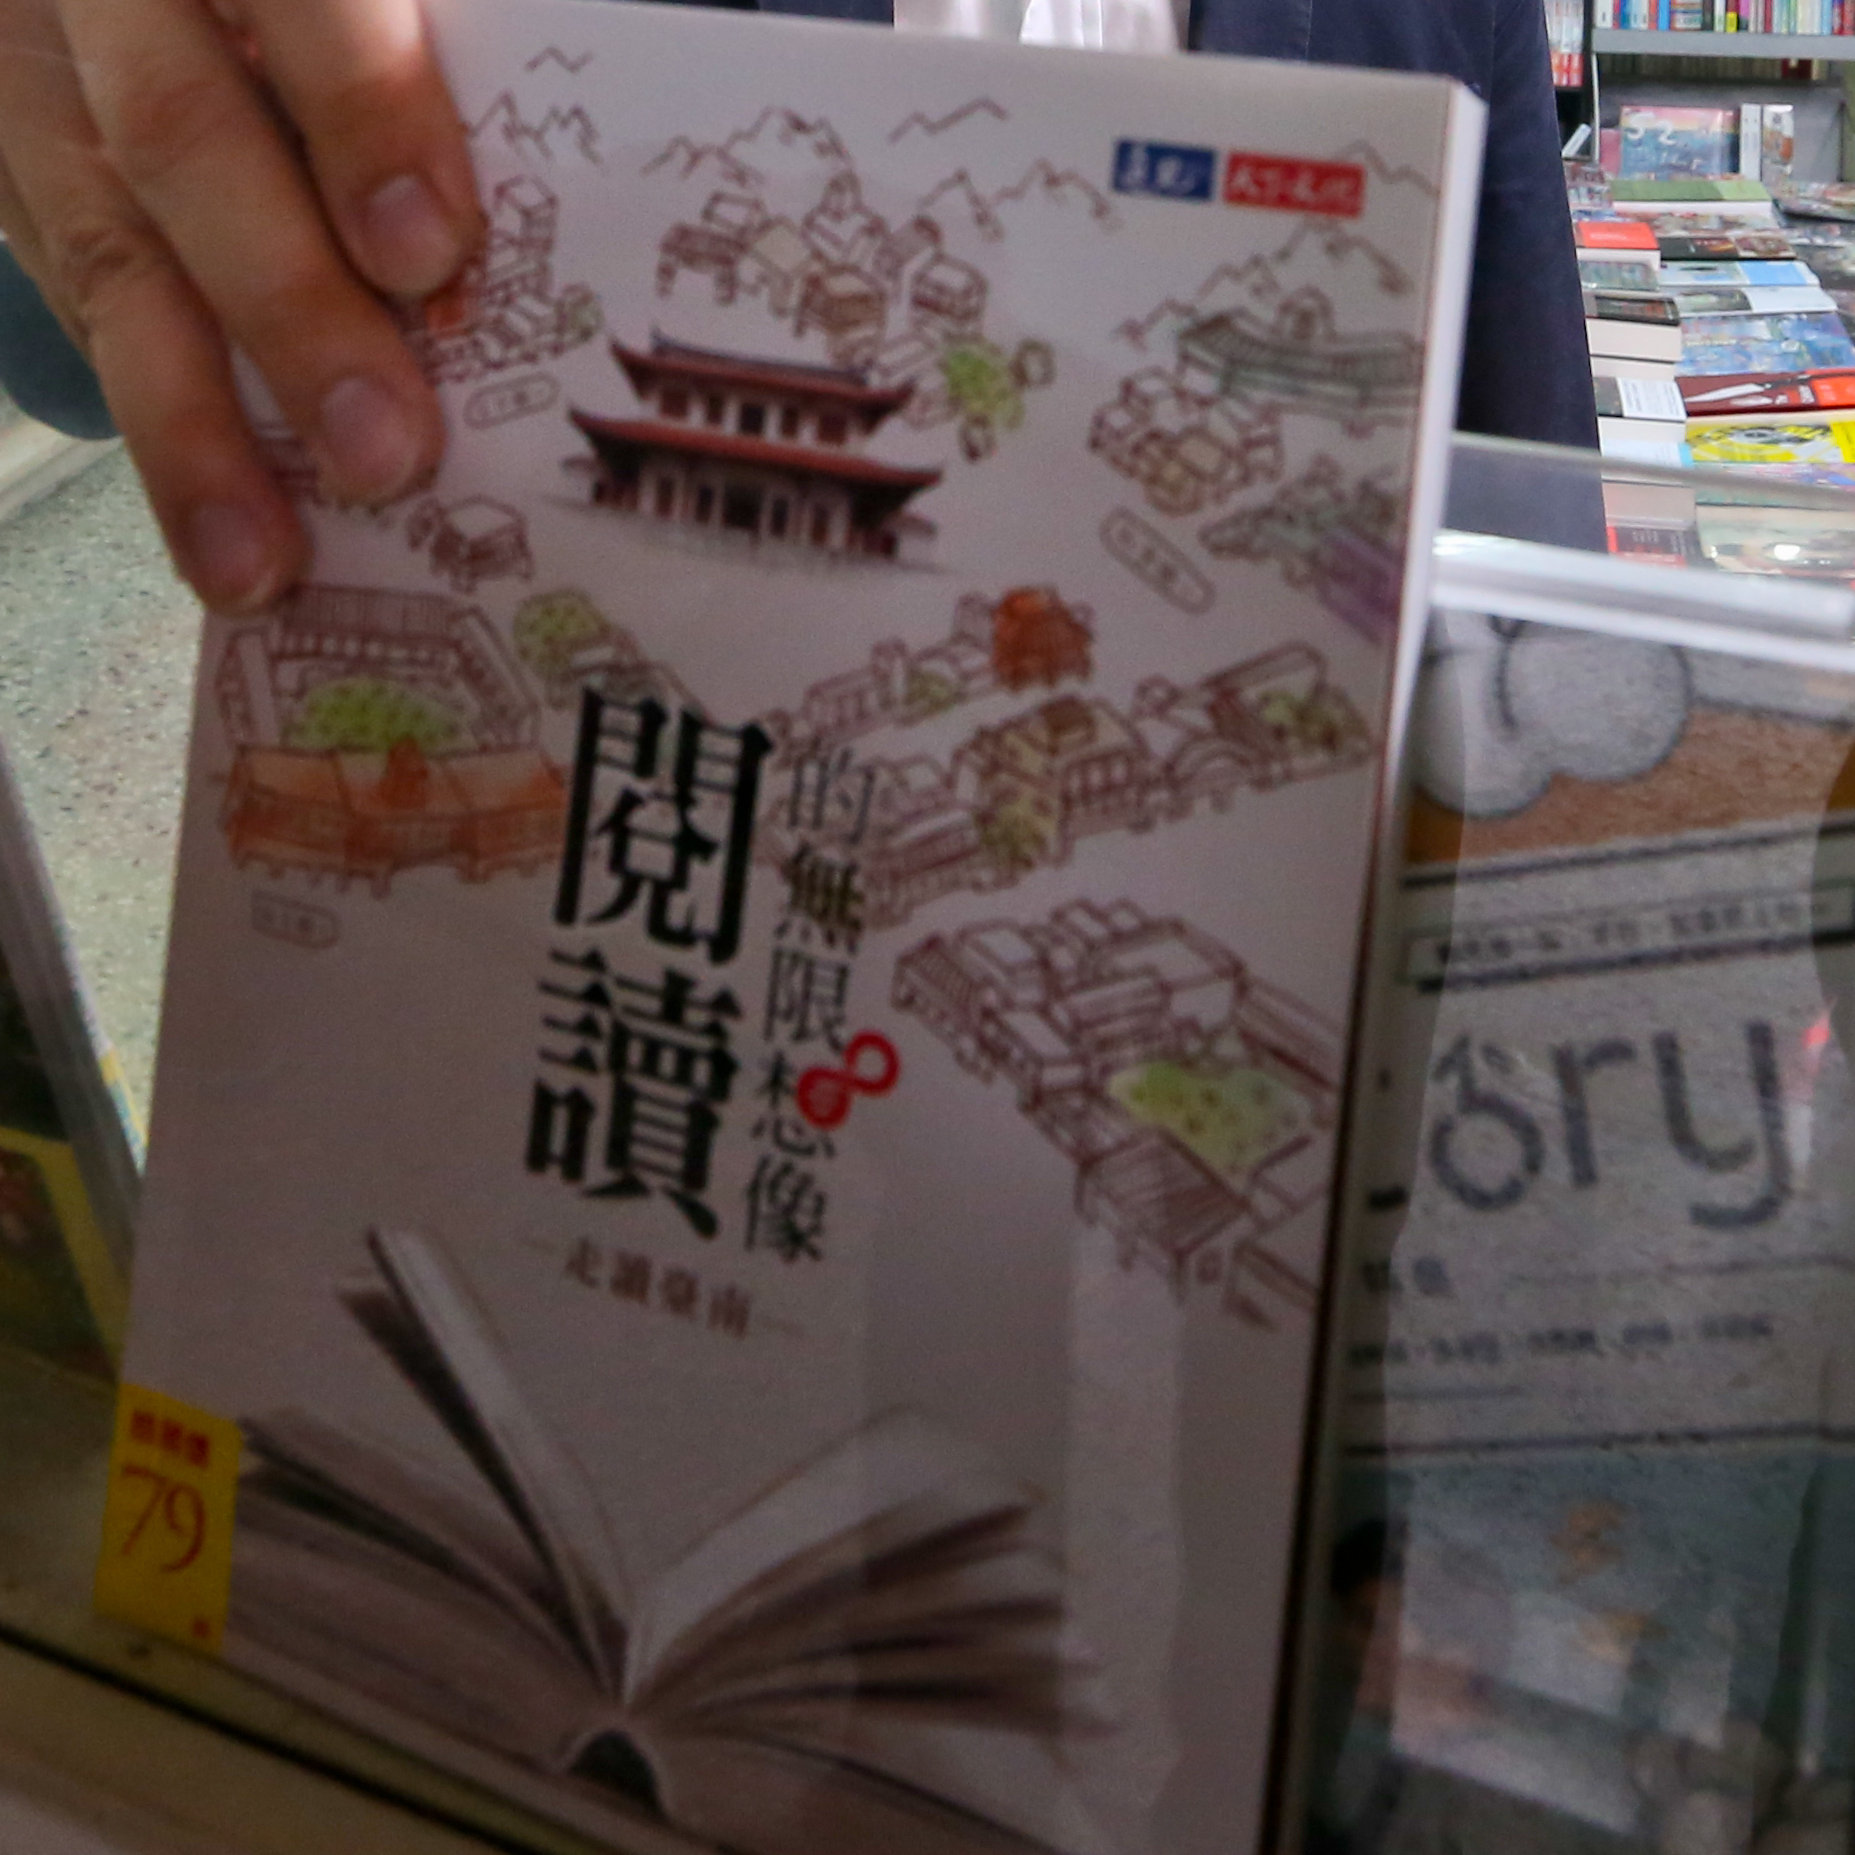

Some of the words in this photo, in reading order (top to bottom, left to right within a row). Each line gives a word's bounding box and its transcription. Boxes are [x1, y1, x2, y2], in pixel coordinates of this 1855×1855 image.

[526, 686, 773, 1240] 閱讀
[745, 745, 876, 1264] 的無限想像
[121, 1463, 207, 1574] 79
